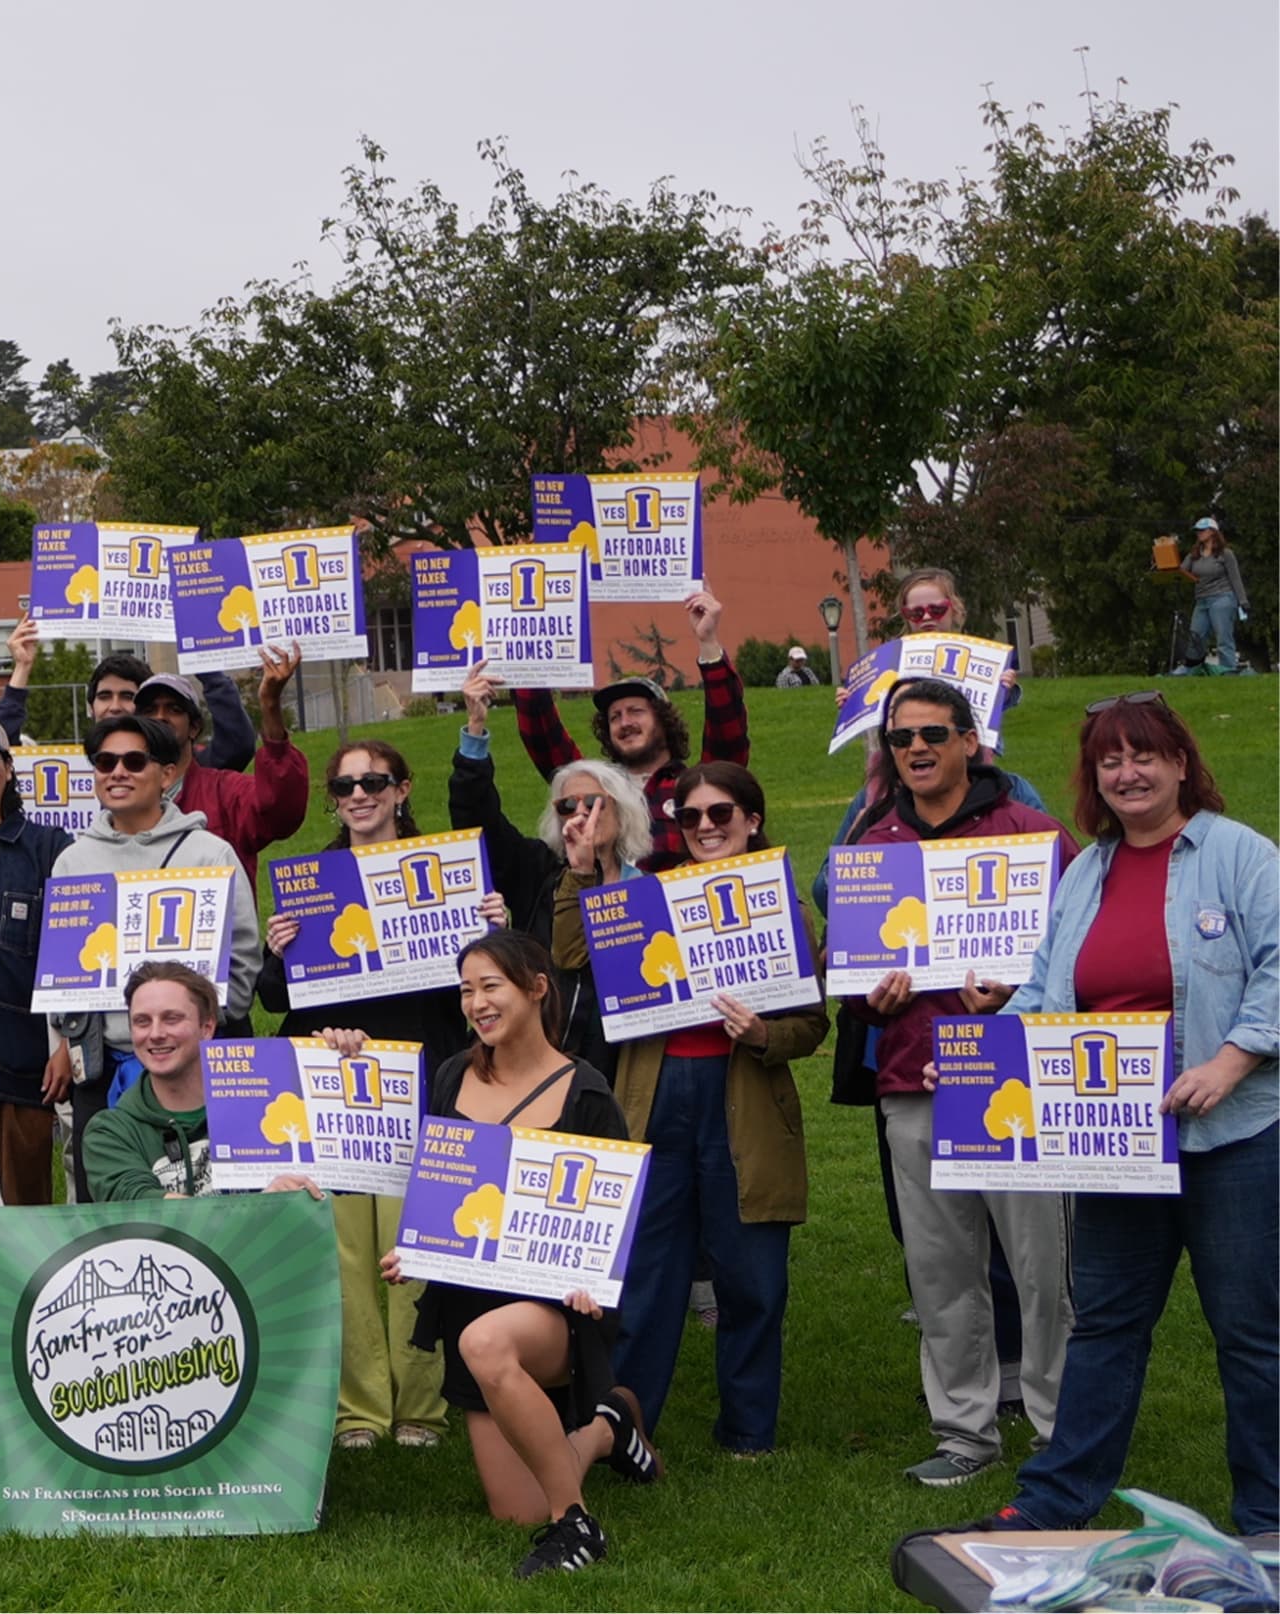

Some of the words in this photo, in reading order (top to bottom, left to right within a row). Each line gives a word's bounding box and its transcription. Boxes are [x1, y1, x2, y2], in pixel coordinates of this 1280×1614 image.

[604, 507, 625, 519] YES
[662, 505, 684, 517] YES
[604, 537, 685, 556] AFFORDABLE
[624, 558, 667, 576] HOMES
[838, 852, 853, 865] NO
[856, 850, 883, 864] NEW
[838, 866, 879, 880] TAXES.
[936, 877, 965, 892] YES
[1010, 873, 1039, 888] YES
[935, 909, 1038, 936] AFFORDABLE
[959, 935, 1015, 958] HOMES
[939, 1024, 954, 1039] NO
[957, 1023, 984, 1038] NEW
[210, 1044, 226, 1057] NO
[229, 1044, 256, 1057] NEW
[939, 1041, 981, 1056] TAXES.
[211, 1059, 254, 1072] TAXES.
[1041, 1059, 1071, 1075] YES
[1120, 1058, 1151, 1075] YES
[311, 1077, 340, 1091] YES
[383, 1079, 410, 1092] YES
[315, 1114, 415, 1135] AFFORDABLE
[1042, 1103, 1153, 1127] AFFORDABLE
[428, 1122, 446, 1138] NO
[446, 1124, 475, 1142] NEW
[342, 1138, 396, 1158] HOMES
[425, 1138, 468, 1158] TAXES.
[1069, 1132, 1128, 1156] HOMES
[518, 1170, 549, 1188] YES
[592, 1181, 623, 1199] YES
[507, 1210, 614, 1246] AFFORDABLE
[525, 1240, 585, 1268] HOMES
[129, 1334, 240, 1397] Housing
